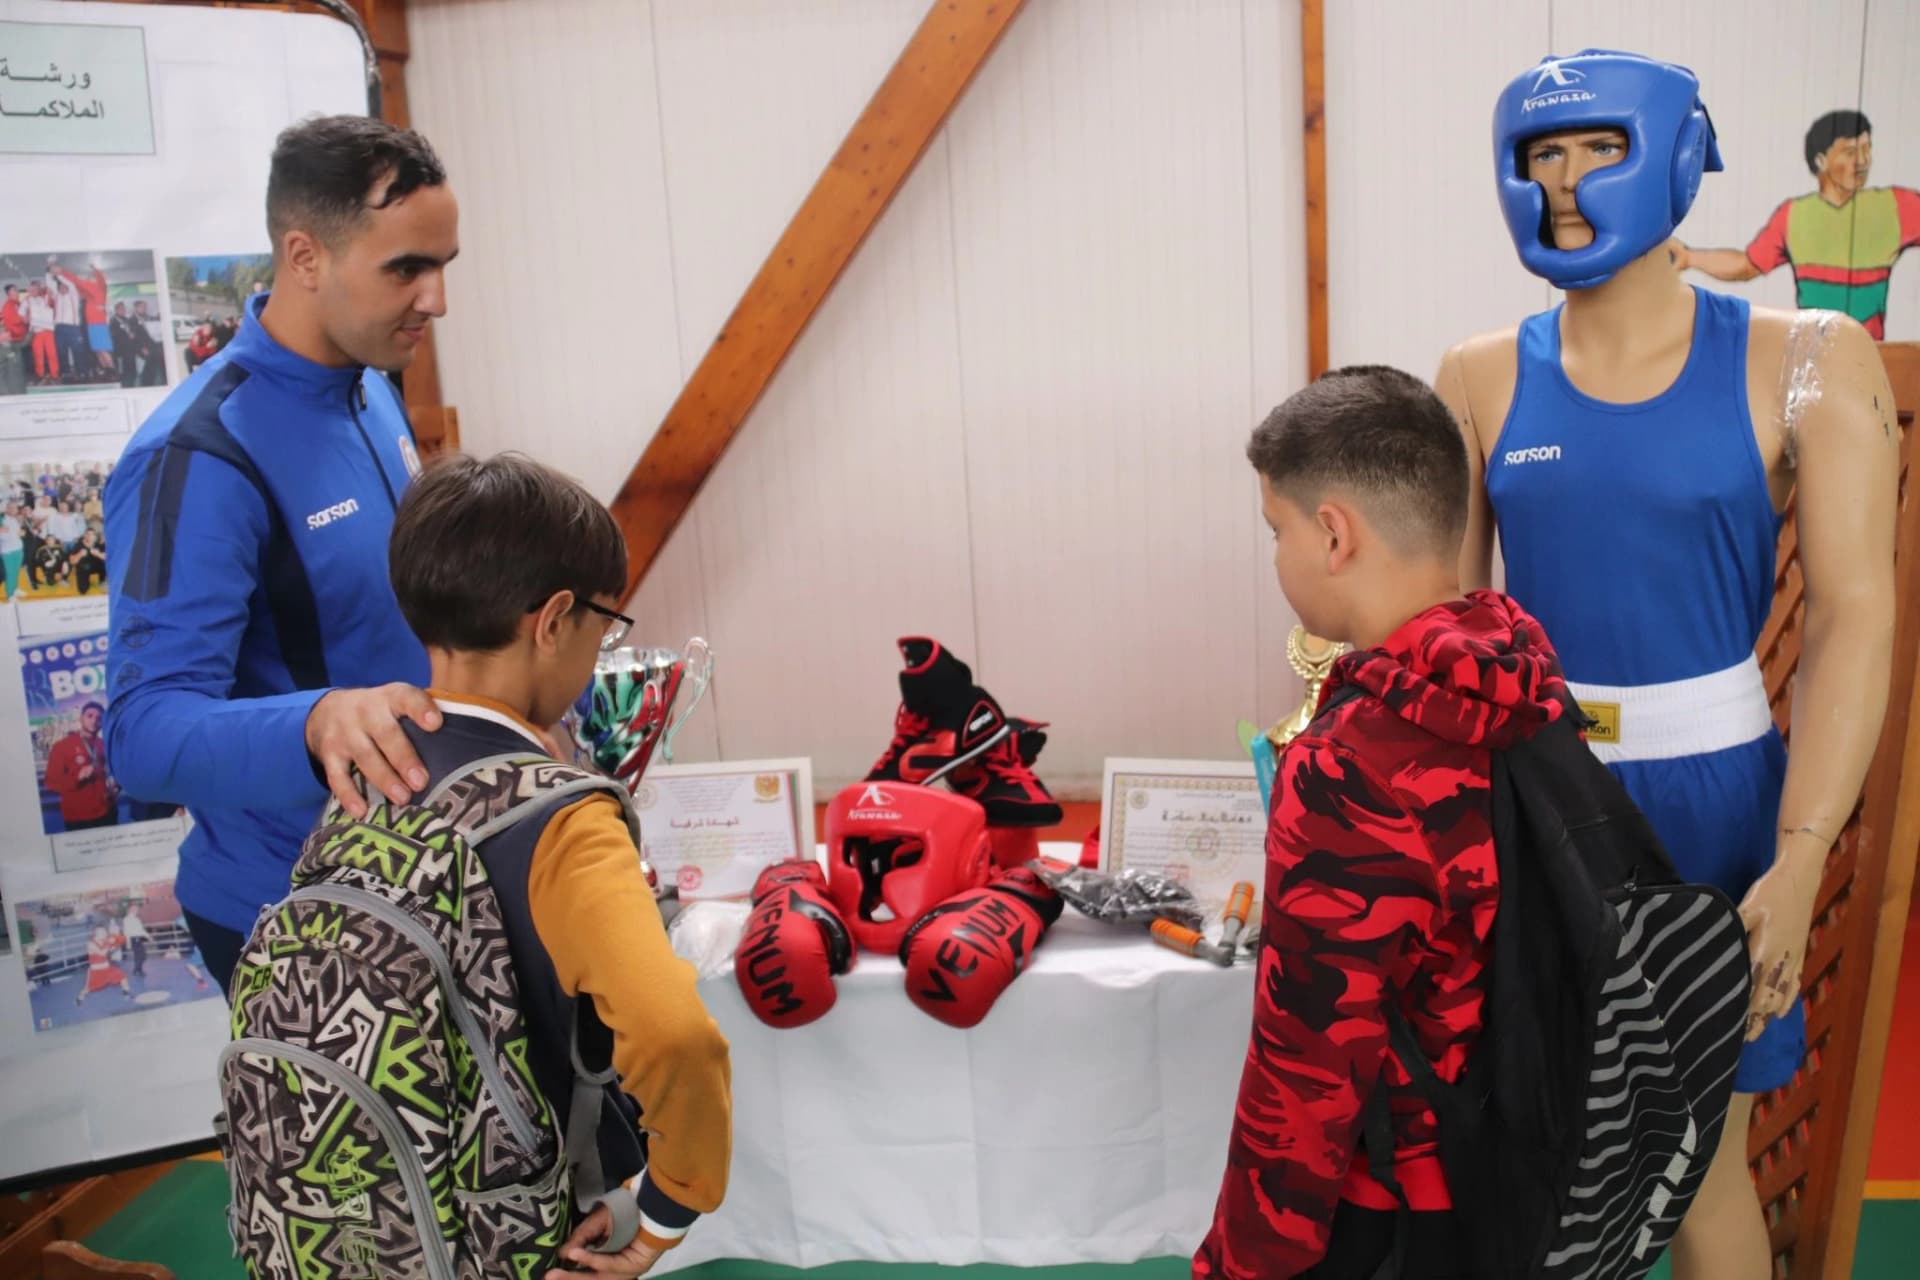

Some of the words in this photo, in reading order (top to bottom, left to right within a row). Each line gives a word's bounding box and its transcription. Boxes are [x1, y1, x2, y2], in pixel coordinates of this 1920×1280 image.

[0, 98, 105, 119] الملاكم
[1504, 445, 1561, 466] sarson
[307, 498, 359, 530] sarson
[920, 898, 1020, 1003] VENUM
